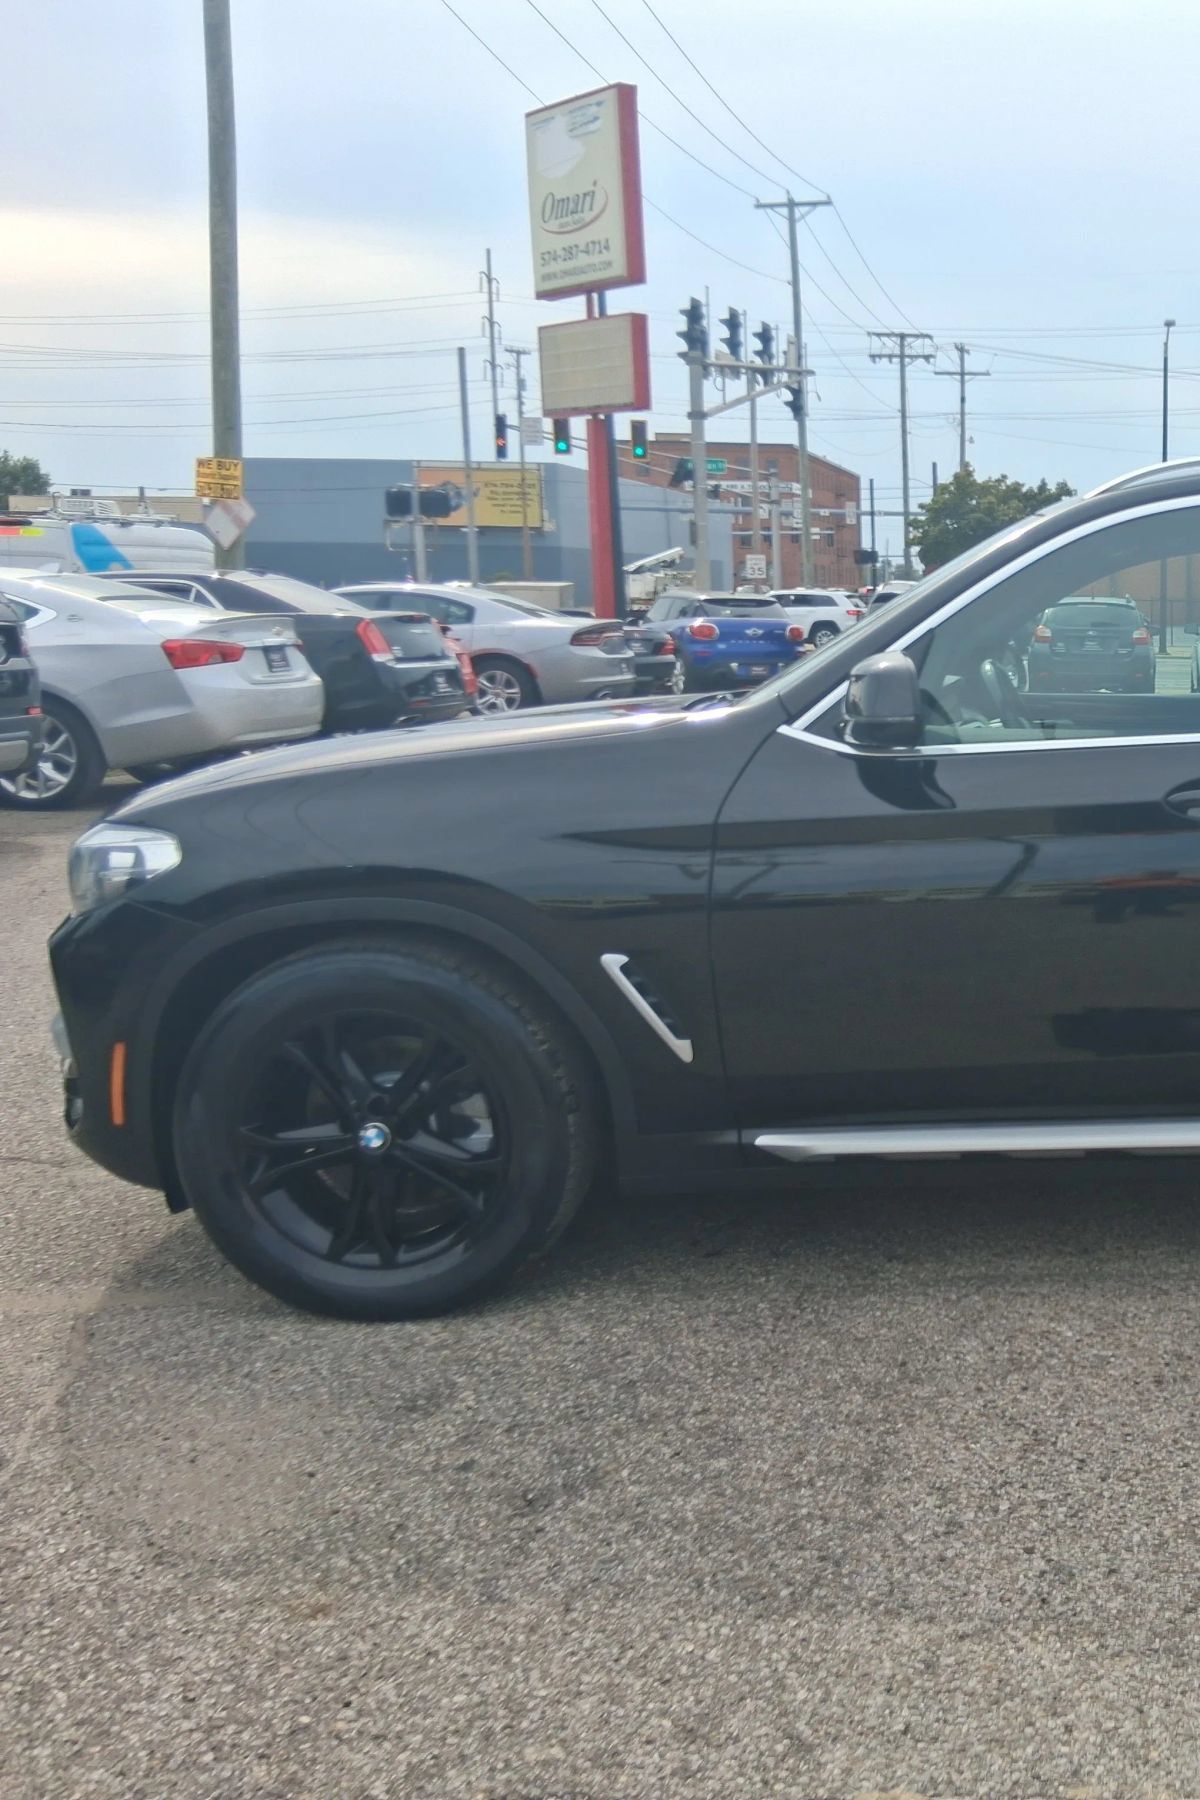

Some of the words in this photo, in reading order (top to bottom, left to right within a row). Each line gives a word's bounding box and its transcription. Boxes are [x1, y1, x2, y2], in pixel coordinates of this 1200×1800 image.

[541, 180, 597, 223] Omari
[541, 238, 610, 267] 574-287-4714
[217, 460, 240, 471] BUY
[750, 567, 765, 576] 35
